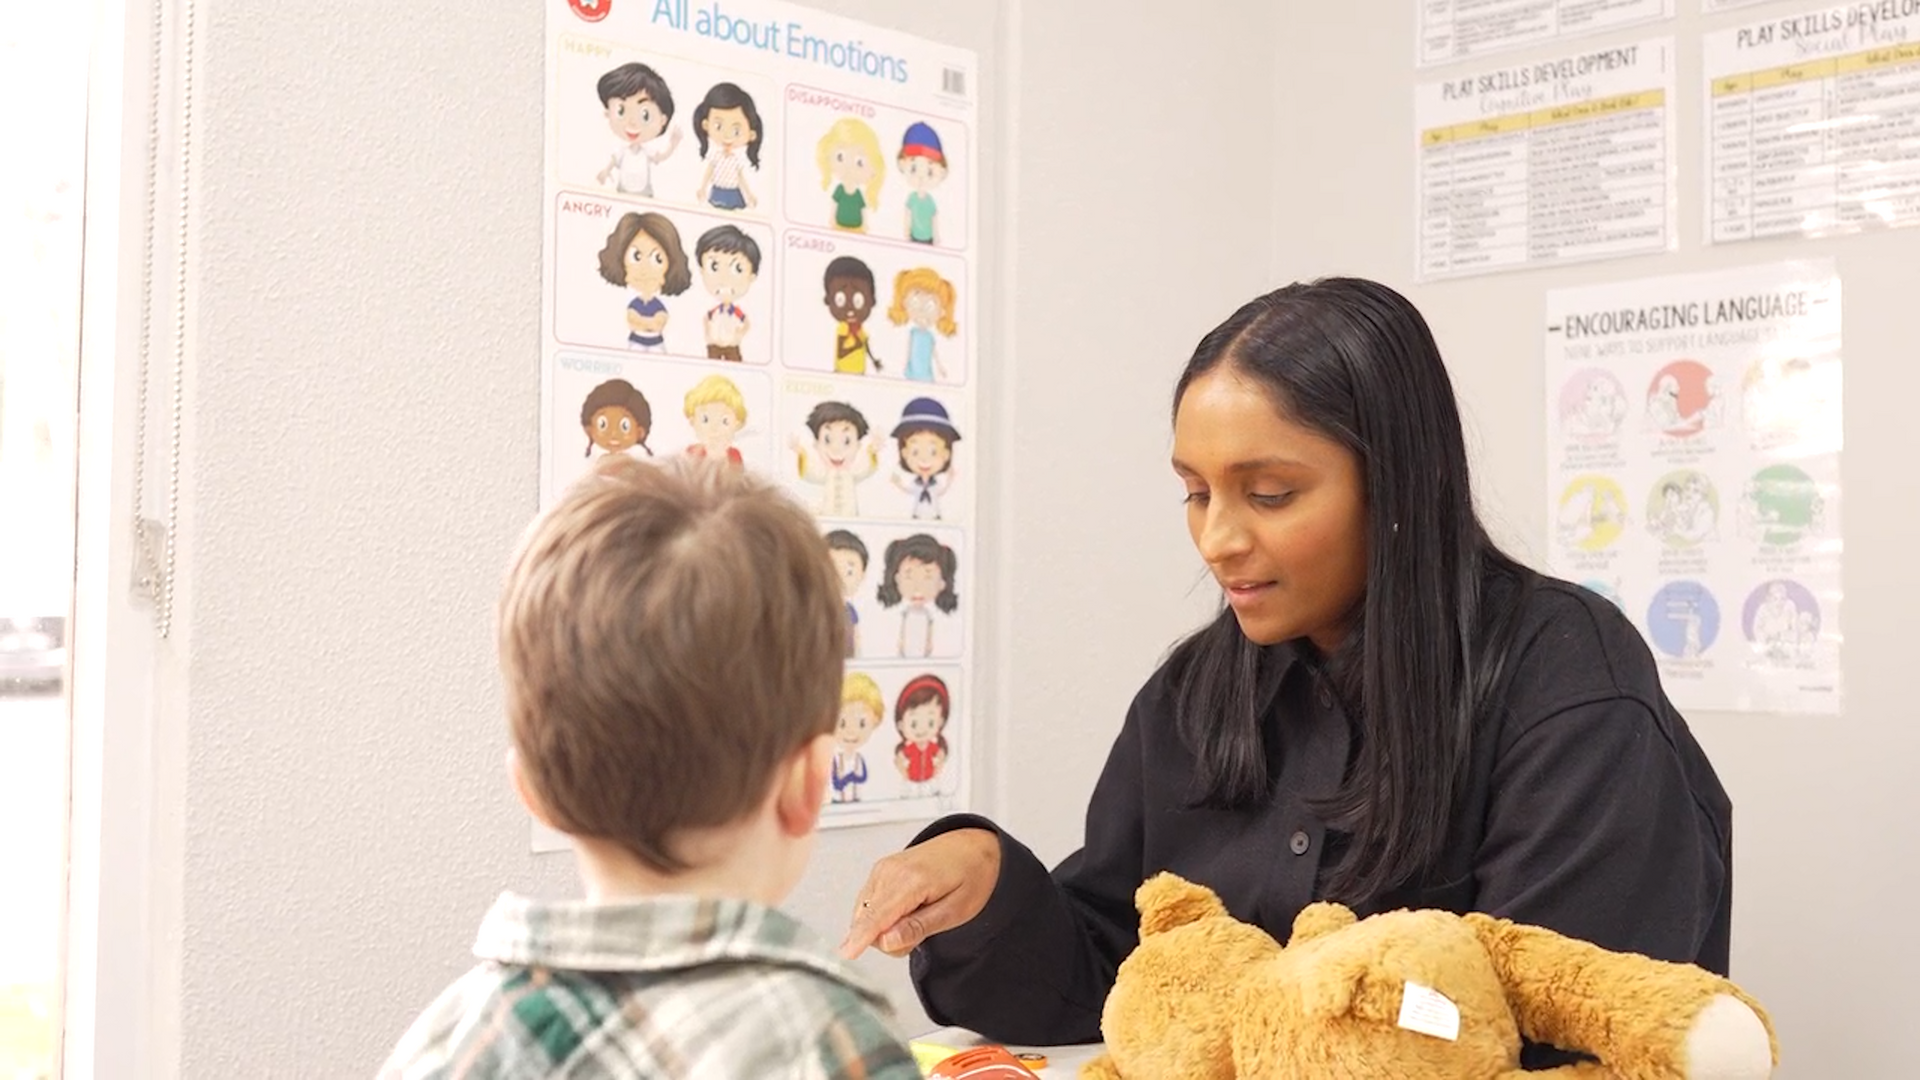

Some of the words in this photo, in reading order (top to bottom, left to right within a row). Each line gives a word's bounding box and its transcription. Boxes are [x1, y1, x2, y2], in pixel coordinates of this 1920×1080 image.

[652, 0, 688, 31] All
[695, 2, 780, 53] about
[786, 22, 908, 83] Emotions
[1737, 24, 1775, 48] PLAY
[1781, 11, 1842, 41] SKILLS
[1858, 22, 1907, 47] Play
[563, 38, 613, 60] HAPPY
[1442, 80, 1474, 101] PLAY
[1479, 67, 1530, 94] SKILLS
[1534, 46, 1639, 84] DEVELOPMENT
[788, 88, 877, 119] DISAPPOINTED
[1553, 79, 1592, 102] Play
[562, 200, 612, 217] ANGRY
[787, 234, 836, 254] SCARED
[1565, 303, 1699, 340] ENCOURAGING
[1704, 291, 1808, 326] LANGUAGE
[1646, 332, 1697, 354] SUPPORT
[1699, 328, 1760, 348] LANGUAGE
